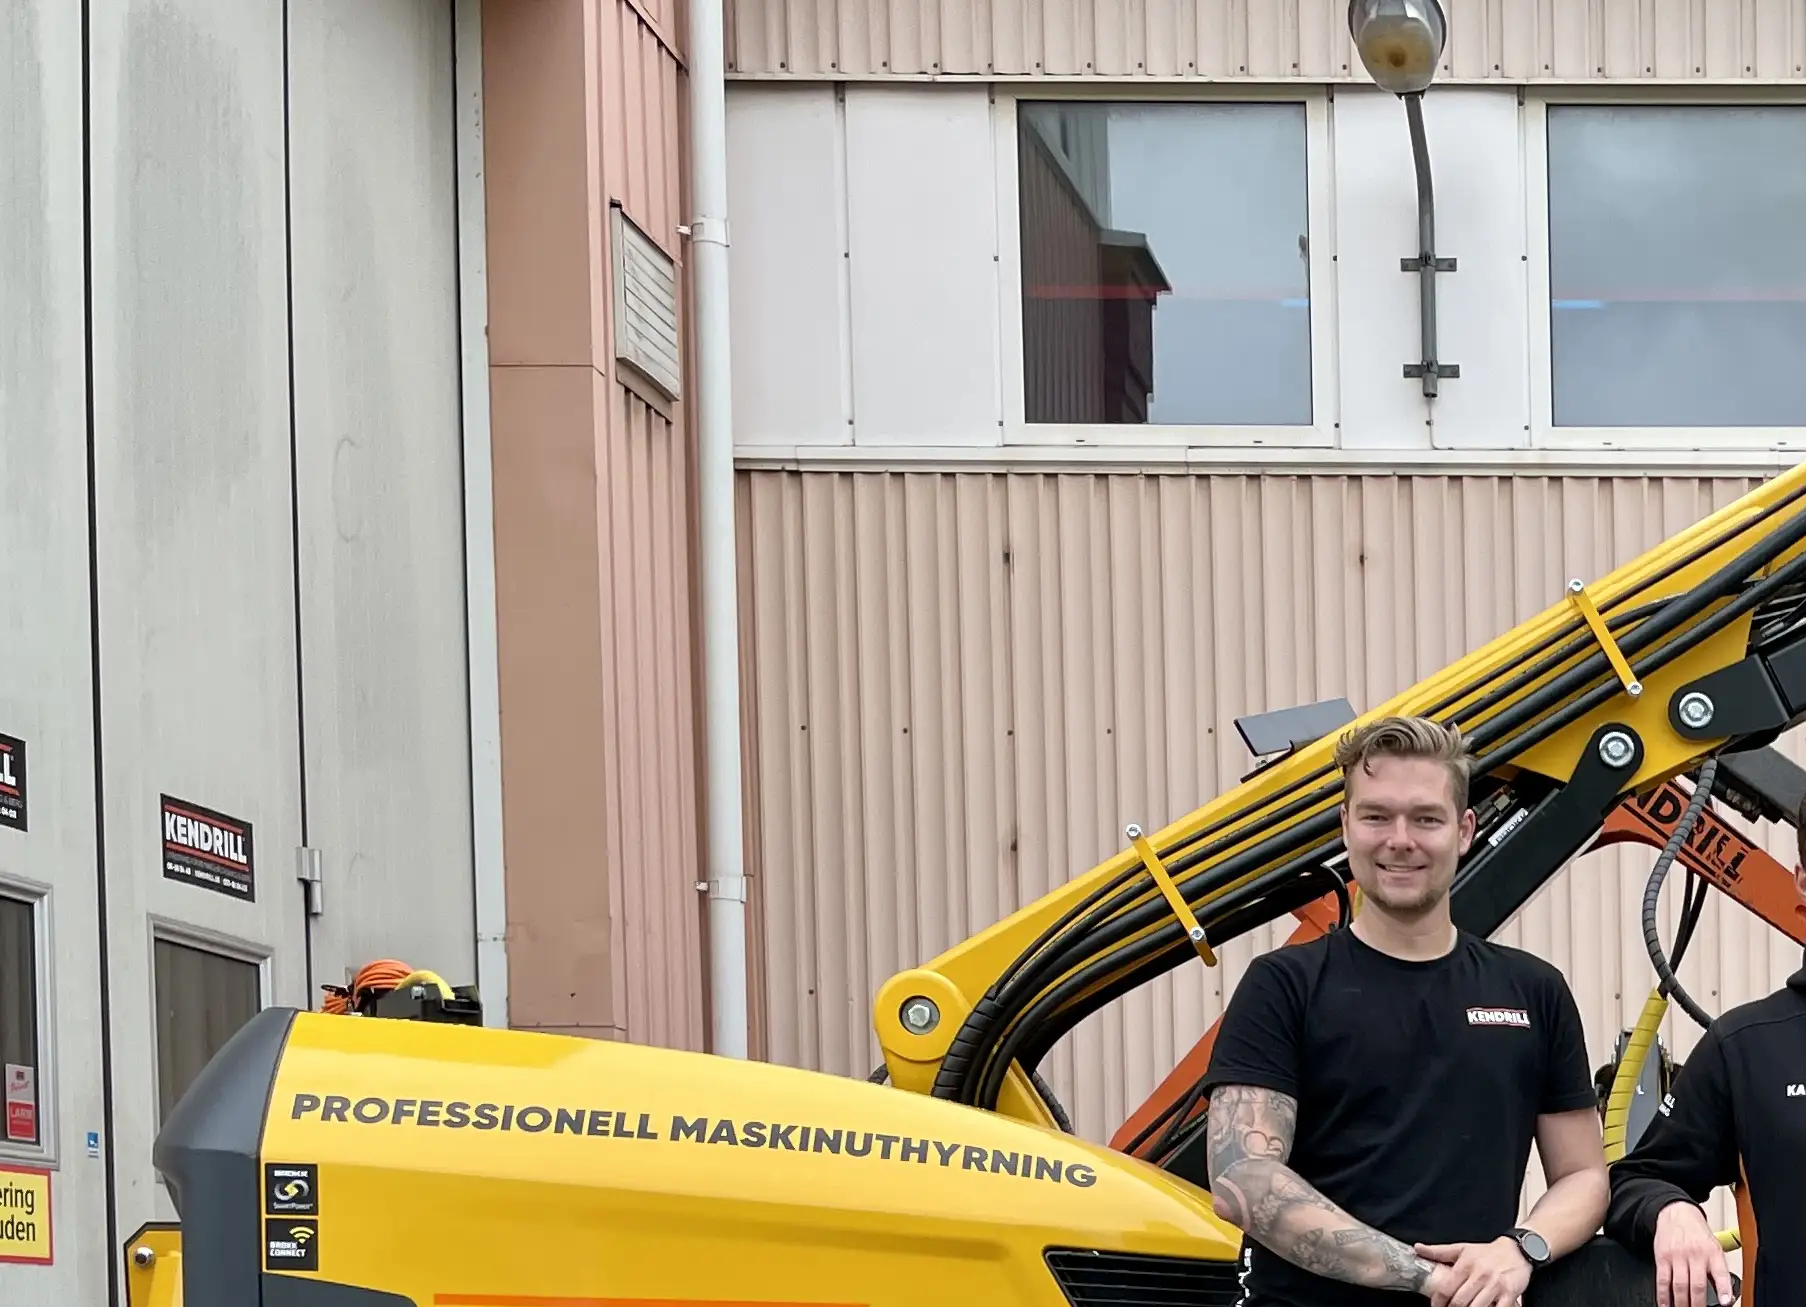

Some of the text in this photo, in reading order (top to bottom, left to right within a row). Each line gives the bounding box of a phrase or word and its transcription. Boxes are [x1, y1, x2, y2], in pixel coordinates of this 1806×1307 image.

[165, 811, 247, 864] KENDRILL
[1467, 1010, 1531, 1025] KENDRILL
[291, 1093, 1097, 1187] PROFESSIONELL MASKINUTHYRNING
